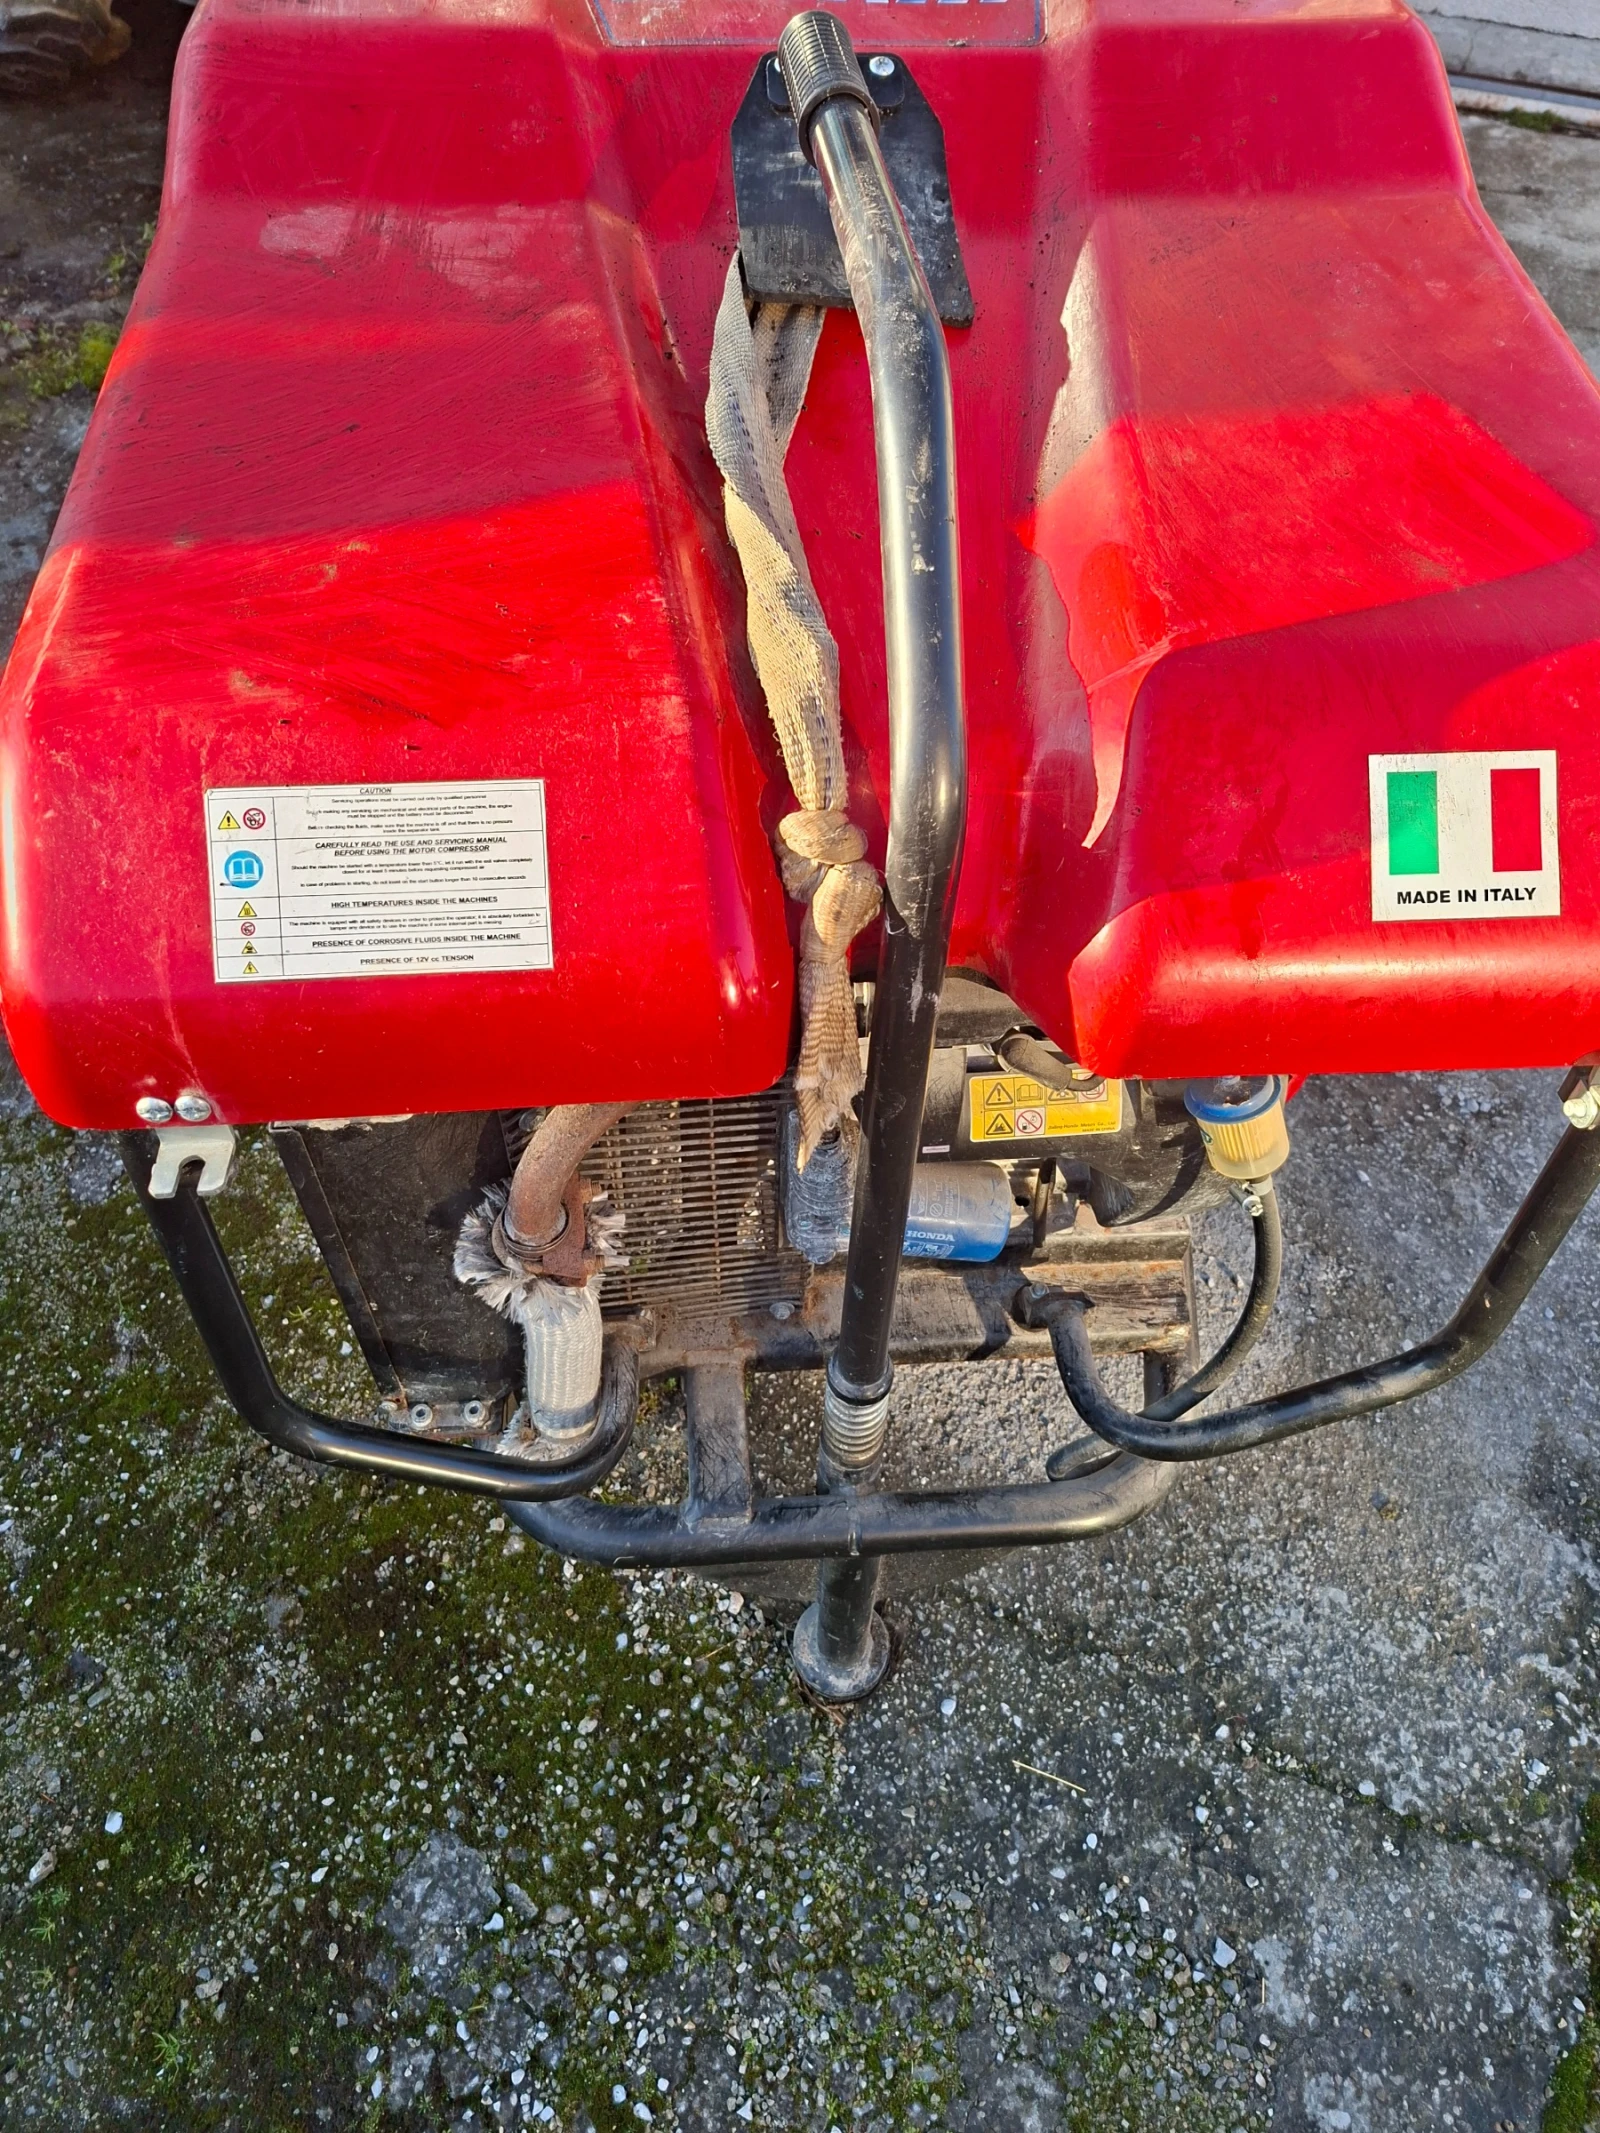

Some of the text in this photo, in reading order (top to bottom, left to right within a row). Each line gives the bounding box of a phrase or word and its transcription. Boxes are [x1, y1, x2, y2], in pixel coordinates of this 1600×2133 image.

[360, 787, 392, 796] CAUTION
[1396, 887, 1537, 905] MADE IN ITALY
[906, 1230, 955, 1242] HONDA
